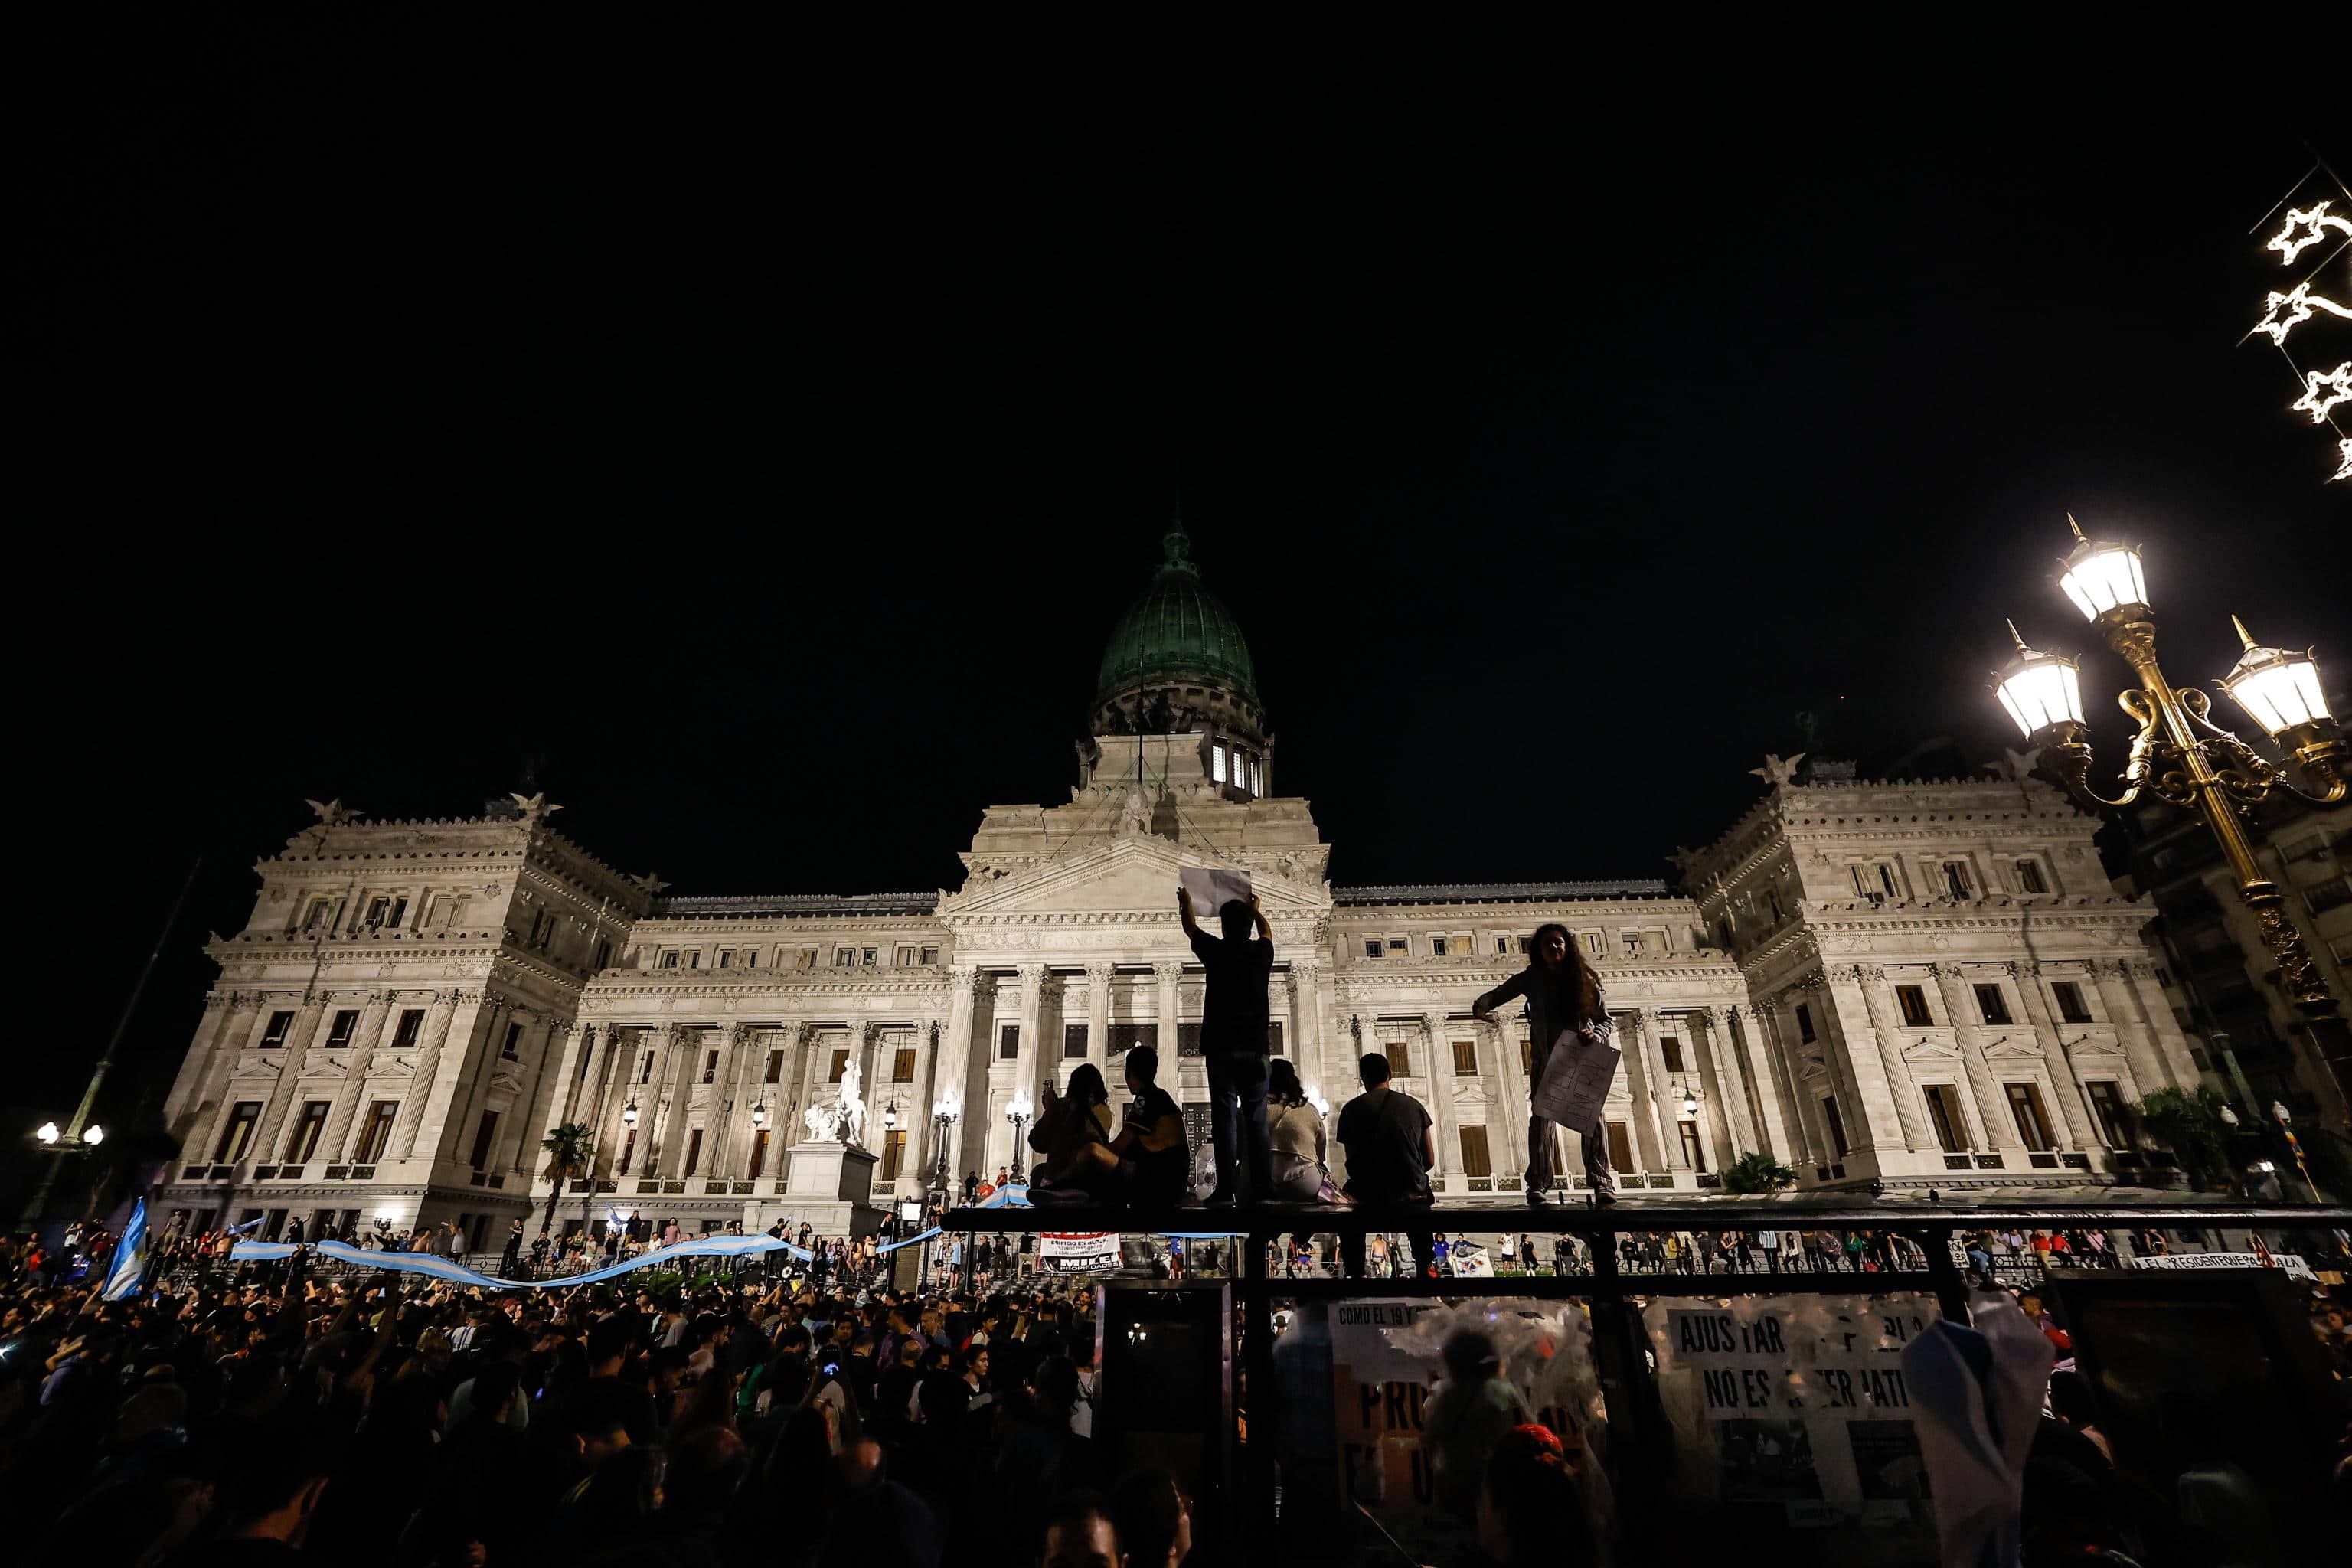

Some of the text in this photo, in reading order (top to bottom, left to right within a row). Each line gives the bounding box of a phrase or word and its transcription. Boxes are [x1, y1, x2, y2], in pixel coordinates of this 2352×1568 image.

[1060, 1255, 1119, 1266] MILEI
[1060, 1262, 1119, 1271] PROPIEDADES
[1339, 1307, 1370, 1325] COMO
[1374, 1307, 1386, 1325] EL
[1390, 1307, 1403, 1325] 19
[1681, 1315, 1785, 1353] AJUSTAR
[1703, 1369, 1739, 1408] NO
[1742, 1369, 1771, 1408] ES
